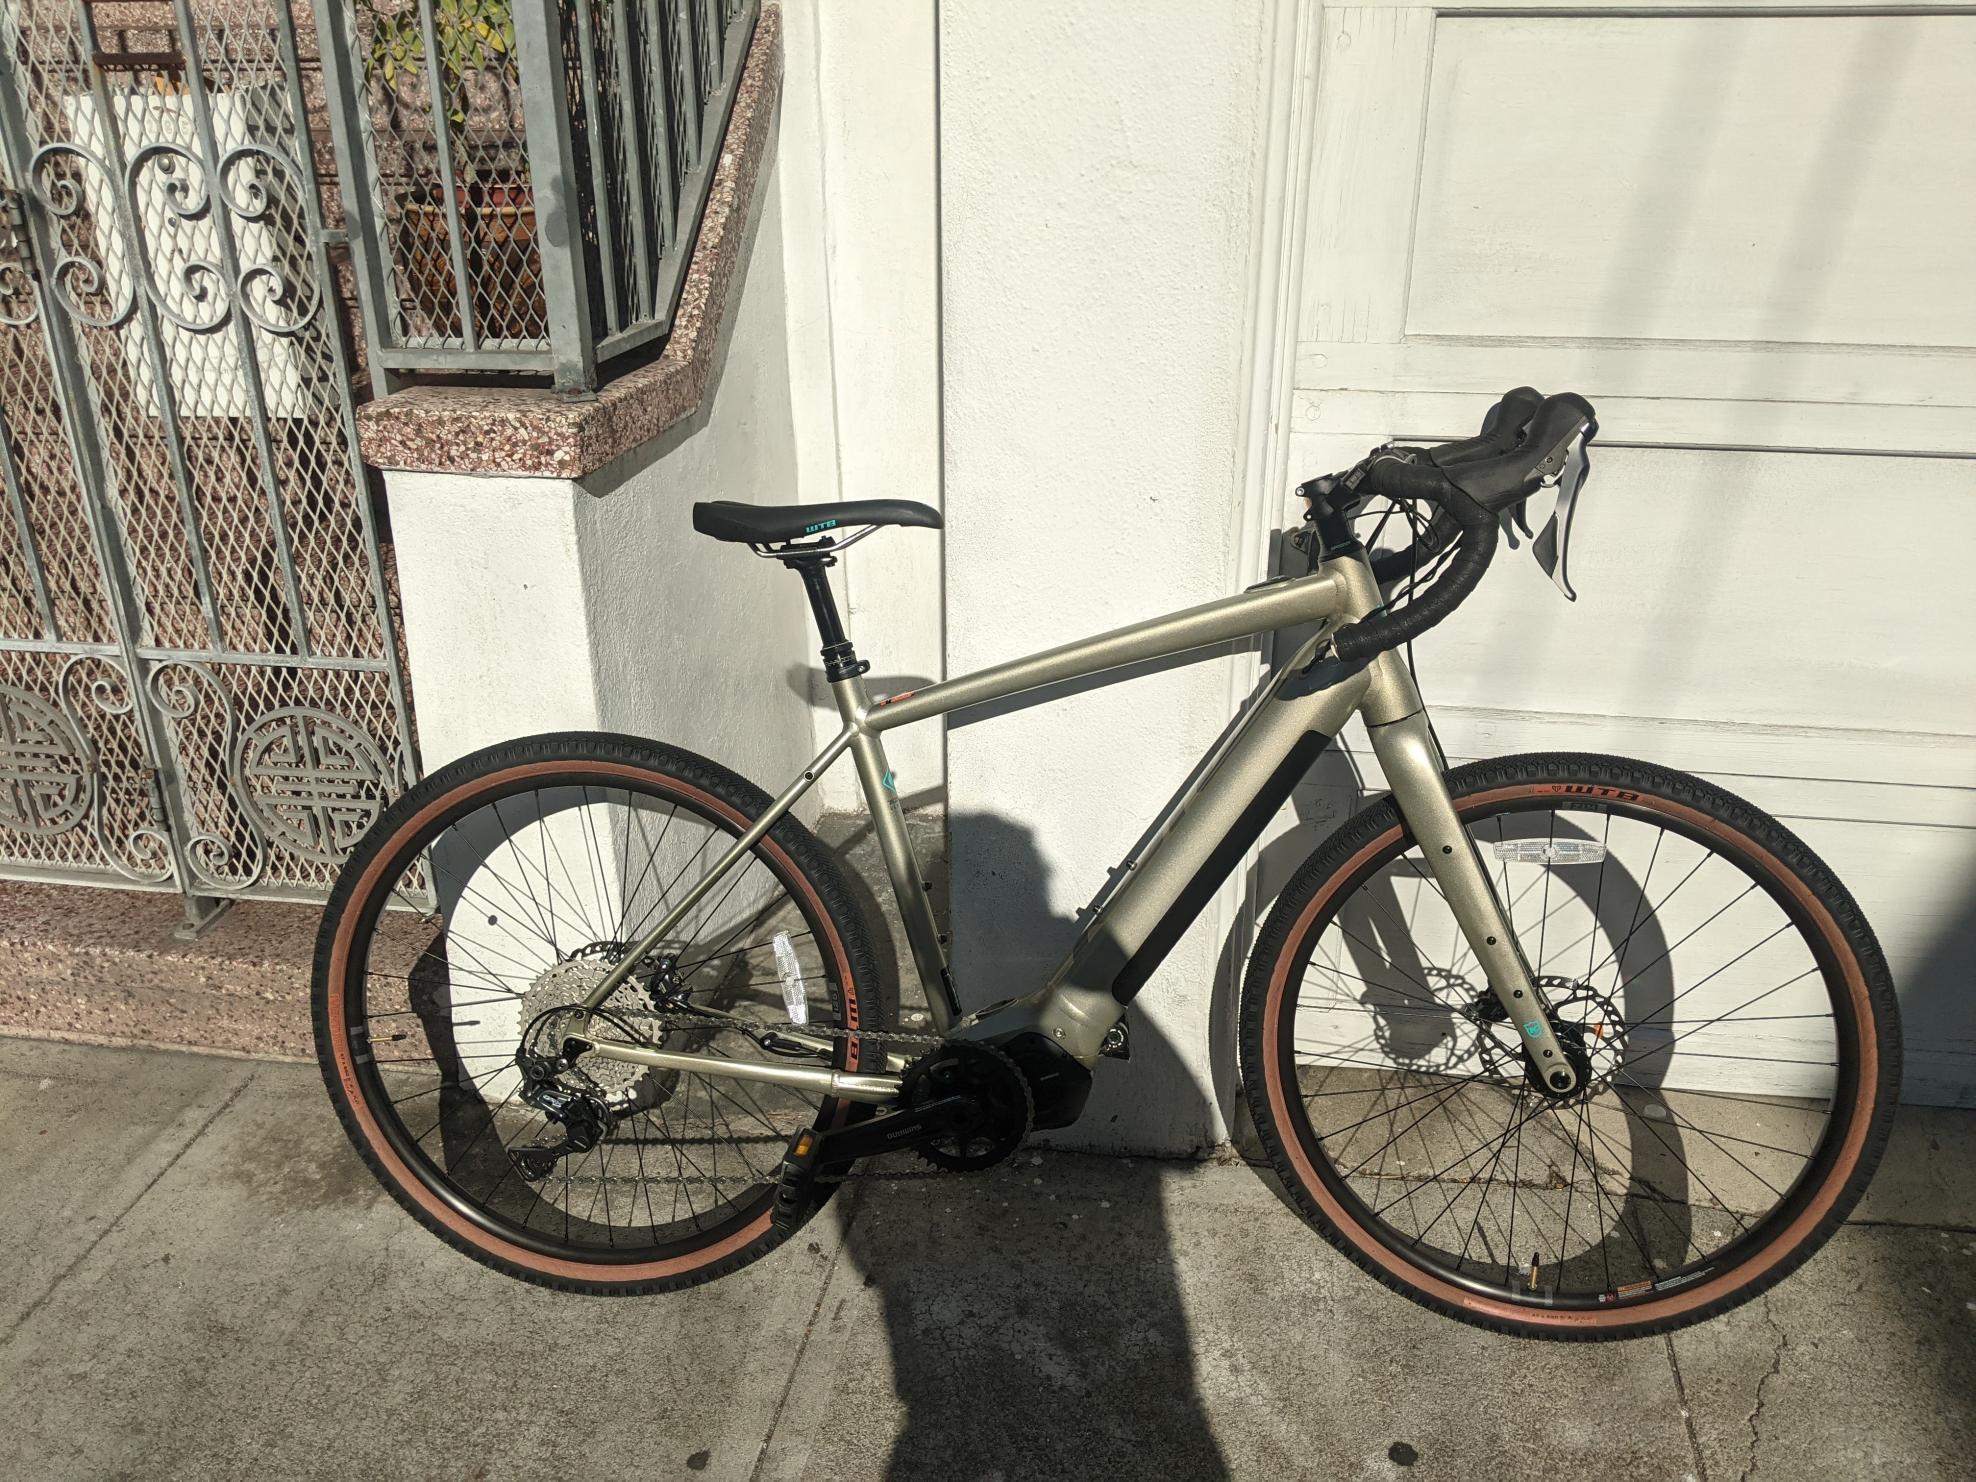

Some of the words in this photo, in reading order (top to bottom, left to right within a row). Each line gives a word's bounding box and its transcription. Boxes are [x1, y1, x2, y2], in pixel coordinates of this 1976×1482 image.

[806, 519, 836, 533] WTB
[1565, 785, 1640, 801] WTB
[848, 998, 859, 1060] WB
